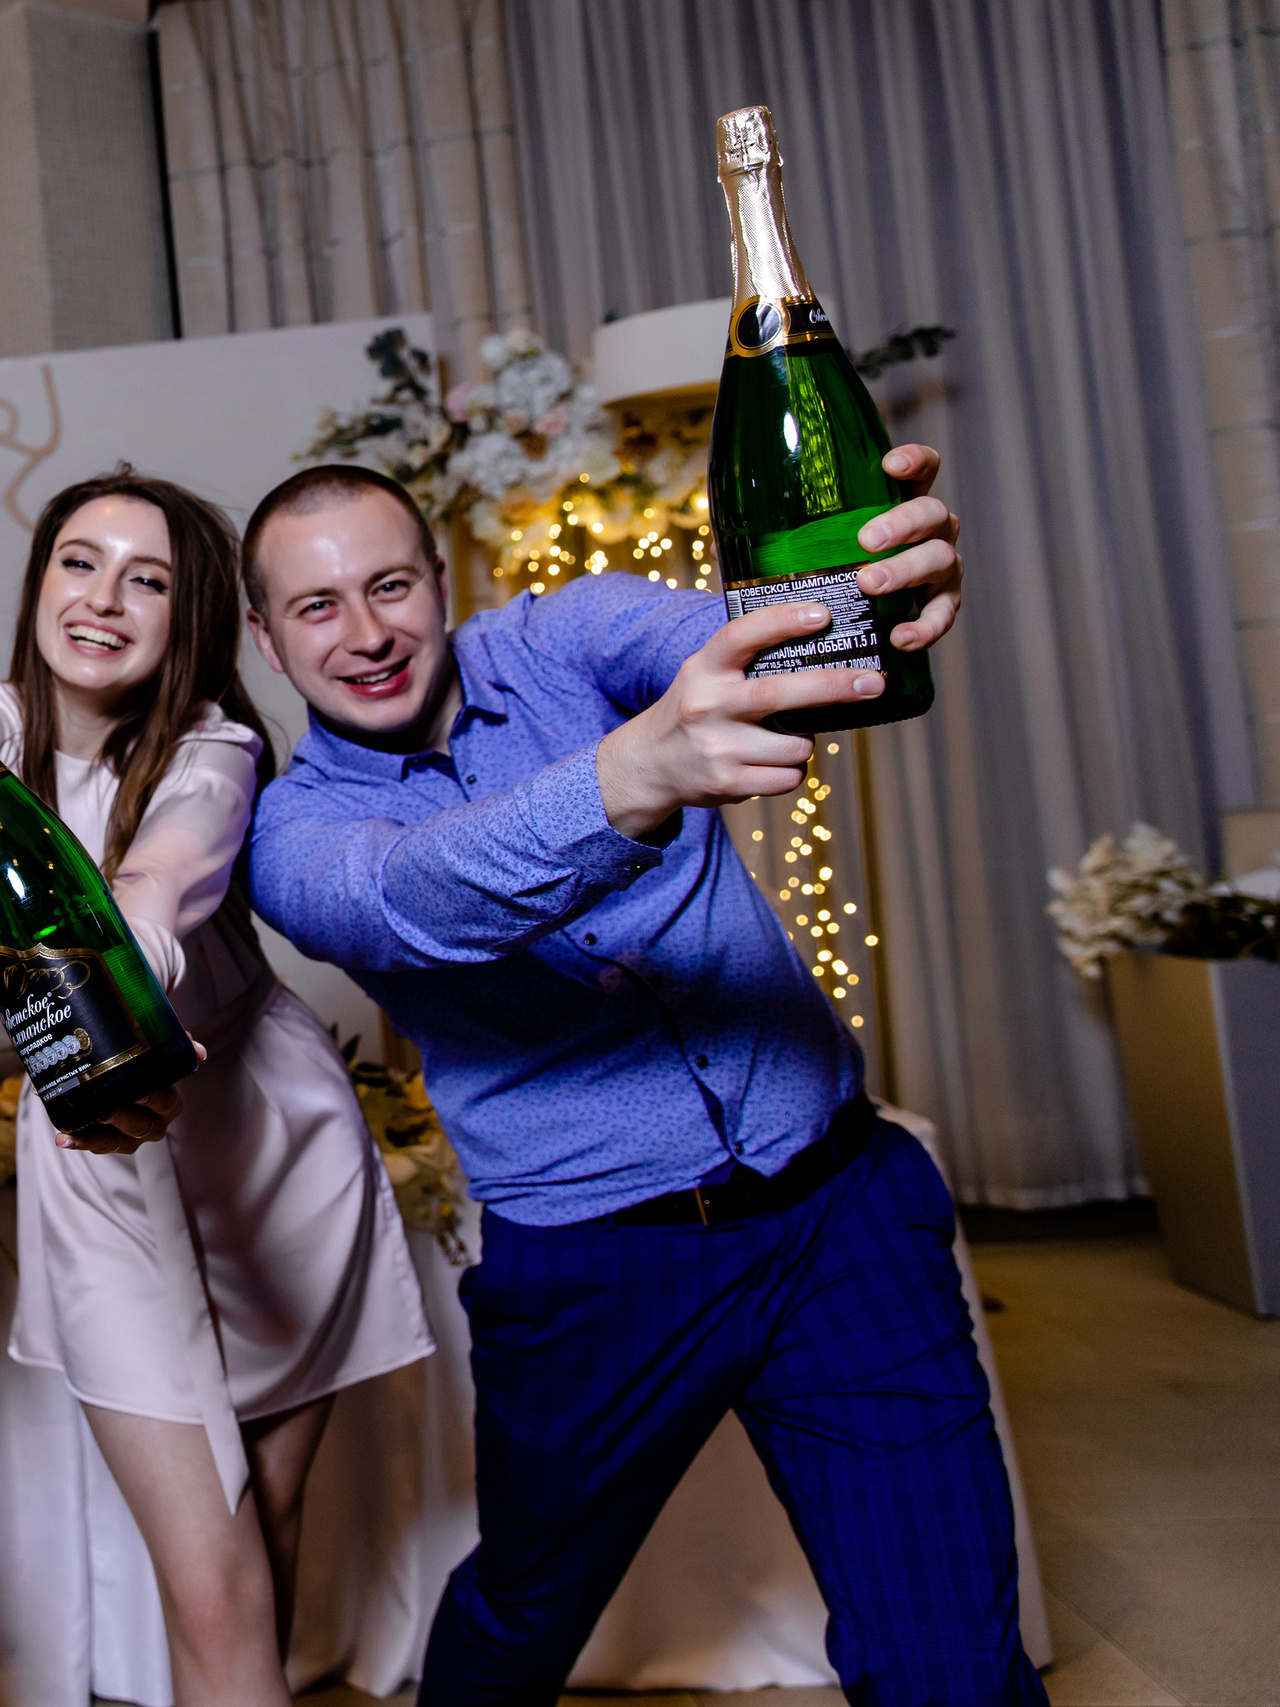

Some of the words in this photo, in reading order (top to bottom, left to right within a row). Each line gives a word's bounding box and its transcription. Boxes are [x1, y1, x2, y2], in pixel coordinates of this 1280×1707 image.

[740, 582, 791, 598] СОВЕТСКОЕ
[790, 571, 860, 591] ШАМПАНСКО
[817, 637, 852, 654] ОБЪЕМ
[870, 632, 878, 645] Л
